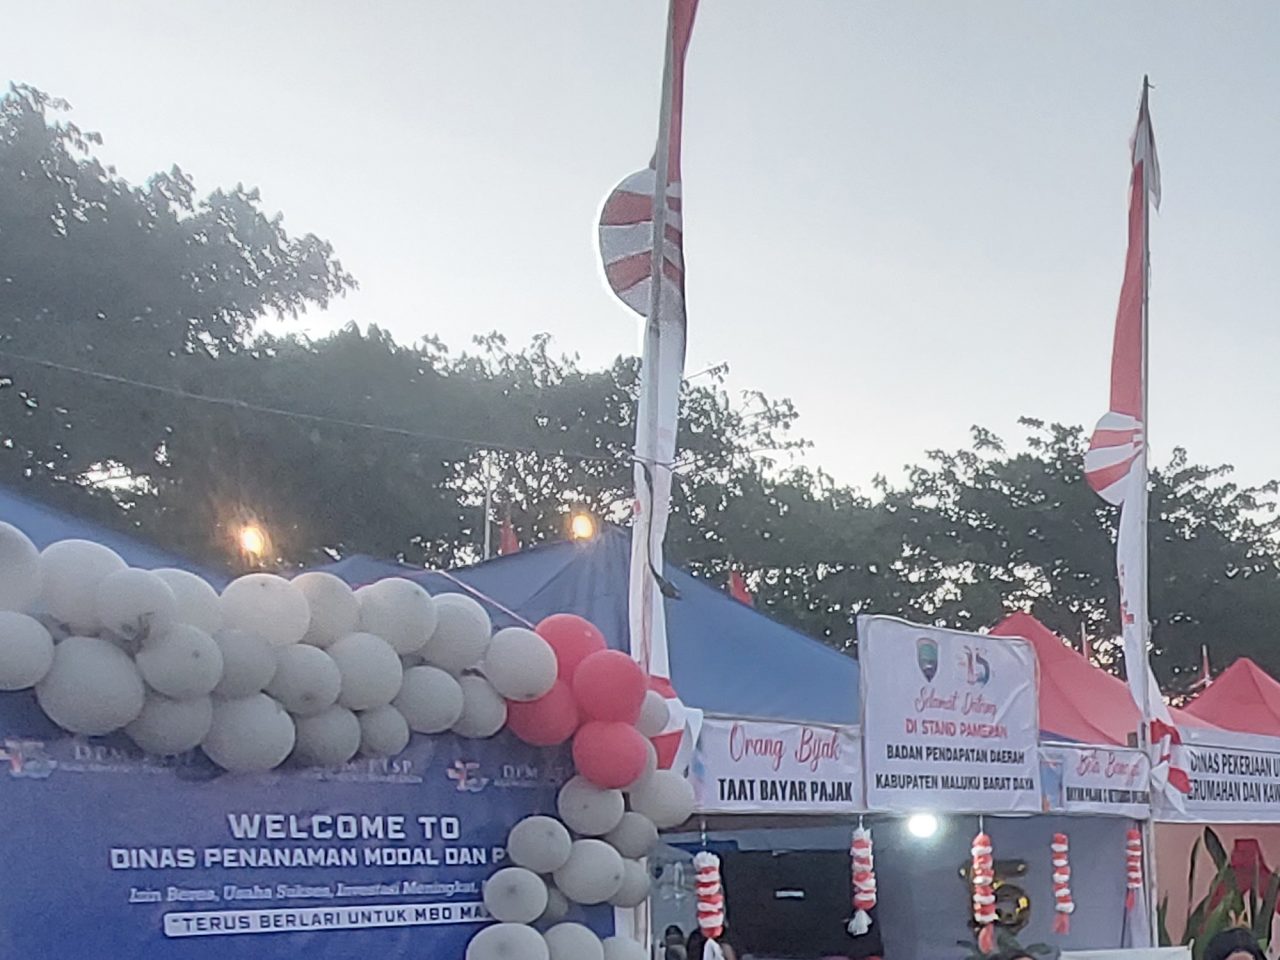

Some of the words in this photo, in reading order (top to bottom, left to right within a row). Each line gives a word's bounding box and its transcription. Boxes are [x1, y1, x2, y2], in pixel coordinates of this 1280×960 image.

[905, 718, 917, 734] DI
[921, 719, 957, 737] STAND
[959, 721, 1008, 739] PAMERAN
[729, 722, 785, 772] Orang
[886, 744, 924, 760] BADAN
[925, 746, 988, 764] PENDAPATAN
[990, 749, 1025, 764] DAERAH
[1190, 750, 1220, 773] DINAS
[1221, 753, 1272, 777] PEKERJAAN
[717, 778, 756, 801] TAAT
[759, 779, 808, 802] BAYAR
[810, 781, 853, 802] PAJAK
[875, 773, 938, 790] KABUPATEN
[941, 775, 981, 791] MALUKU
[982, 776, 1011, 791] BARAT
[1013, 777, 1035, 791] DAYA
[1187, 778, 1241, 802] ERUMAHAN
[1242, 781, 1261, 802] DAN
[227, 813, 406, 840] WELCOME
[417, 815, 460, 840] TO
[110, 848, 196, 869] DINAS
[204, 847, 356, 868] PENANAMAN
[365, 847, 440, 866] MODAL
[445, 847, 487, 865] DAN
[259, 911, 341, 929] BERLARI
[347, 908, 407, 925] UNTUK
[415, 907, 453, 922] MBD
